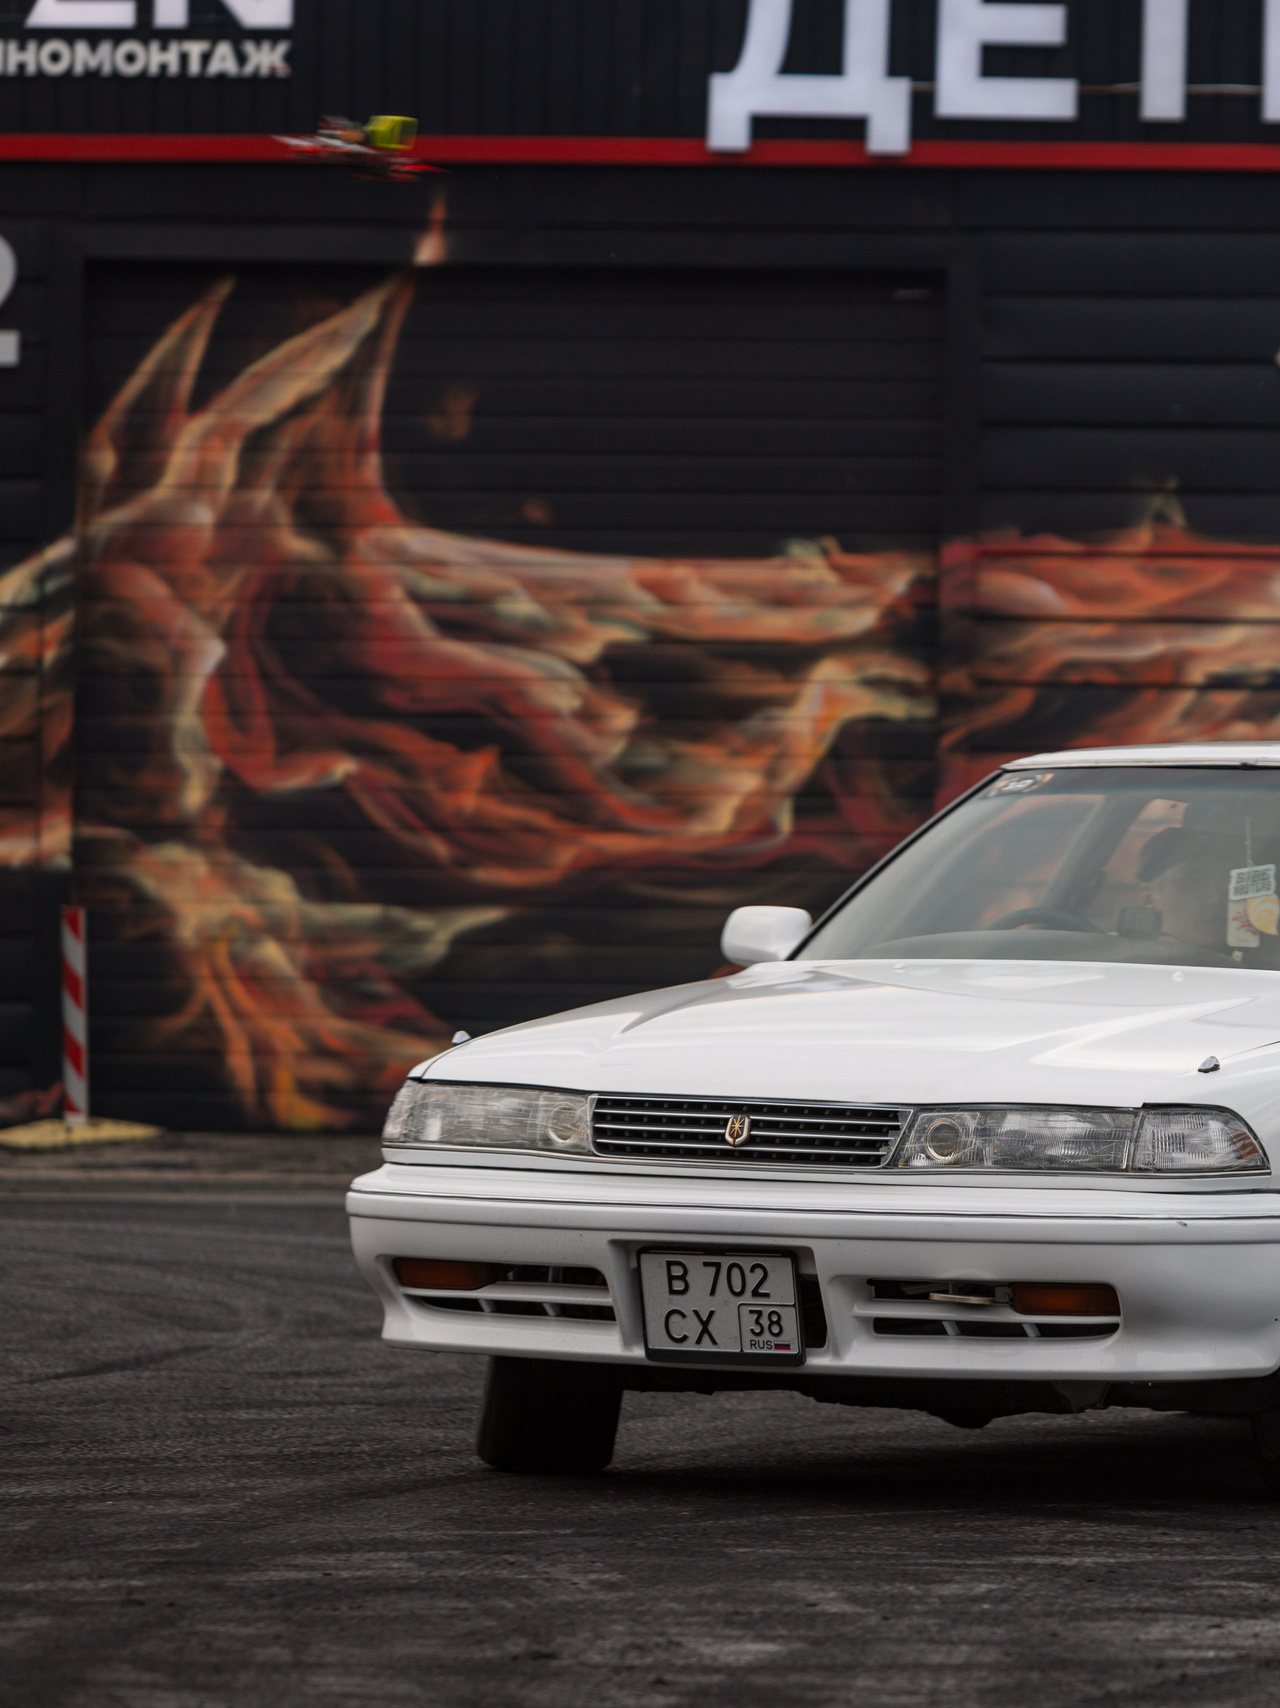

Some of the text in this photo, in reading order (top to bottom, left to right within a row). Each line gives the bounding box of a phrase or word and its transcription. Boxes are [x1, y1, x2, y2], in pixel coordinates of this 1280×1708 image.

[0, 38, 291, 77] НОМОНТАЖ
[665, 1260, 771, 1298] В 702
[664, 1308, 719, 1346] СХ
[748, 1309, 784, 1338] 38
[749, 1339, 773, 1350] RUS
